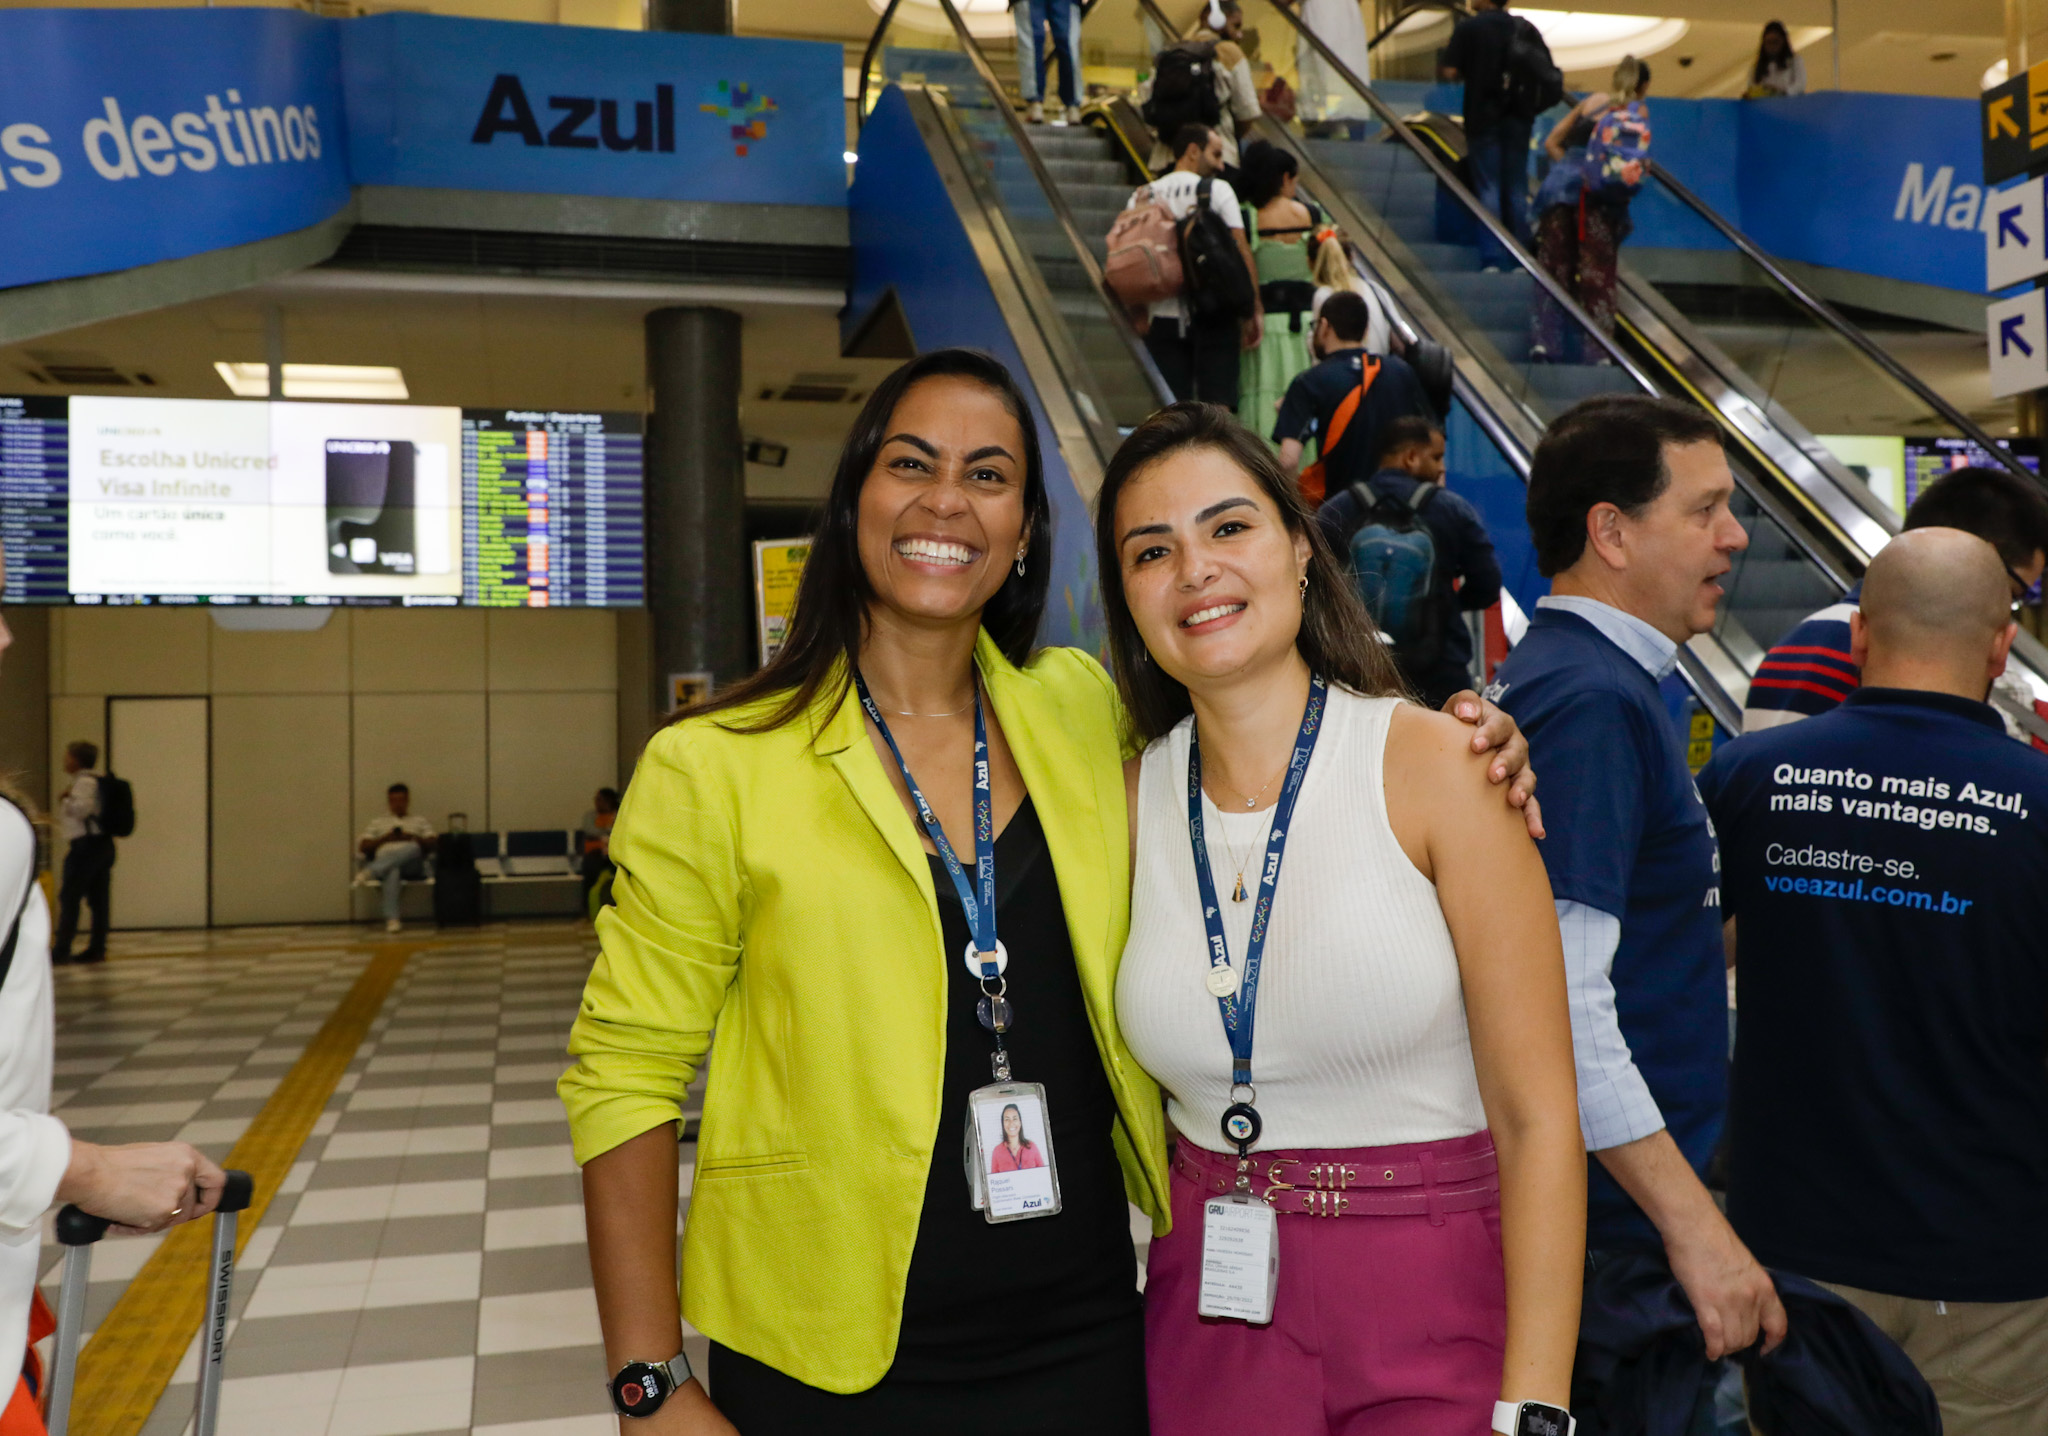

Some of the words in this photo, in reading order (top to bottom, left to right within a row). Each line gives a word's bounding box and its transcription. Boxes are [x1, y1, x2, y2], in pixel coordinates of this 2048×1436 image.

[471, 74, 675, 154] Azul
[0, 122, 62, 191] s
[83, 90, 321, 181] destinos
[100, 450, 186, 468] Escolha
[194, 452, 279, 470] Unicred
[98, 479, 145, 496] Visa
[152, 480, 231, 498] Infinite
[95, 507, 122, 520] Um
[862, 697, 881, 723] Azul
[1294, 745, 1311, 771] AZUL
[975, 760, 989, 790] Azul
[1774, 764, 1873, 790] Quanto
[1881, 777, 1950, 801] mais
[1957, 782, 2029, 820] Azul,
[1770, 789, 1833, 813] mais
[1841, 797, 1997, 836] vantagens.
[983, 851, 993, 881] AZUL
[1263, 852, 1280, 887] Azul
[1765, 843, 1920, 880] Cadastre-se.
[1765, 876, 1973, 916] voeazul.com.br
[1210, 935, 1227, 966] Azul
[1247, 954, 1260, 986] AZUL
[1022, 1198, 1042, 1209] Azul
[1208, 1205, 1225, 1216] GRU
[211, 1250, 232, 1365] SWISSPORT
